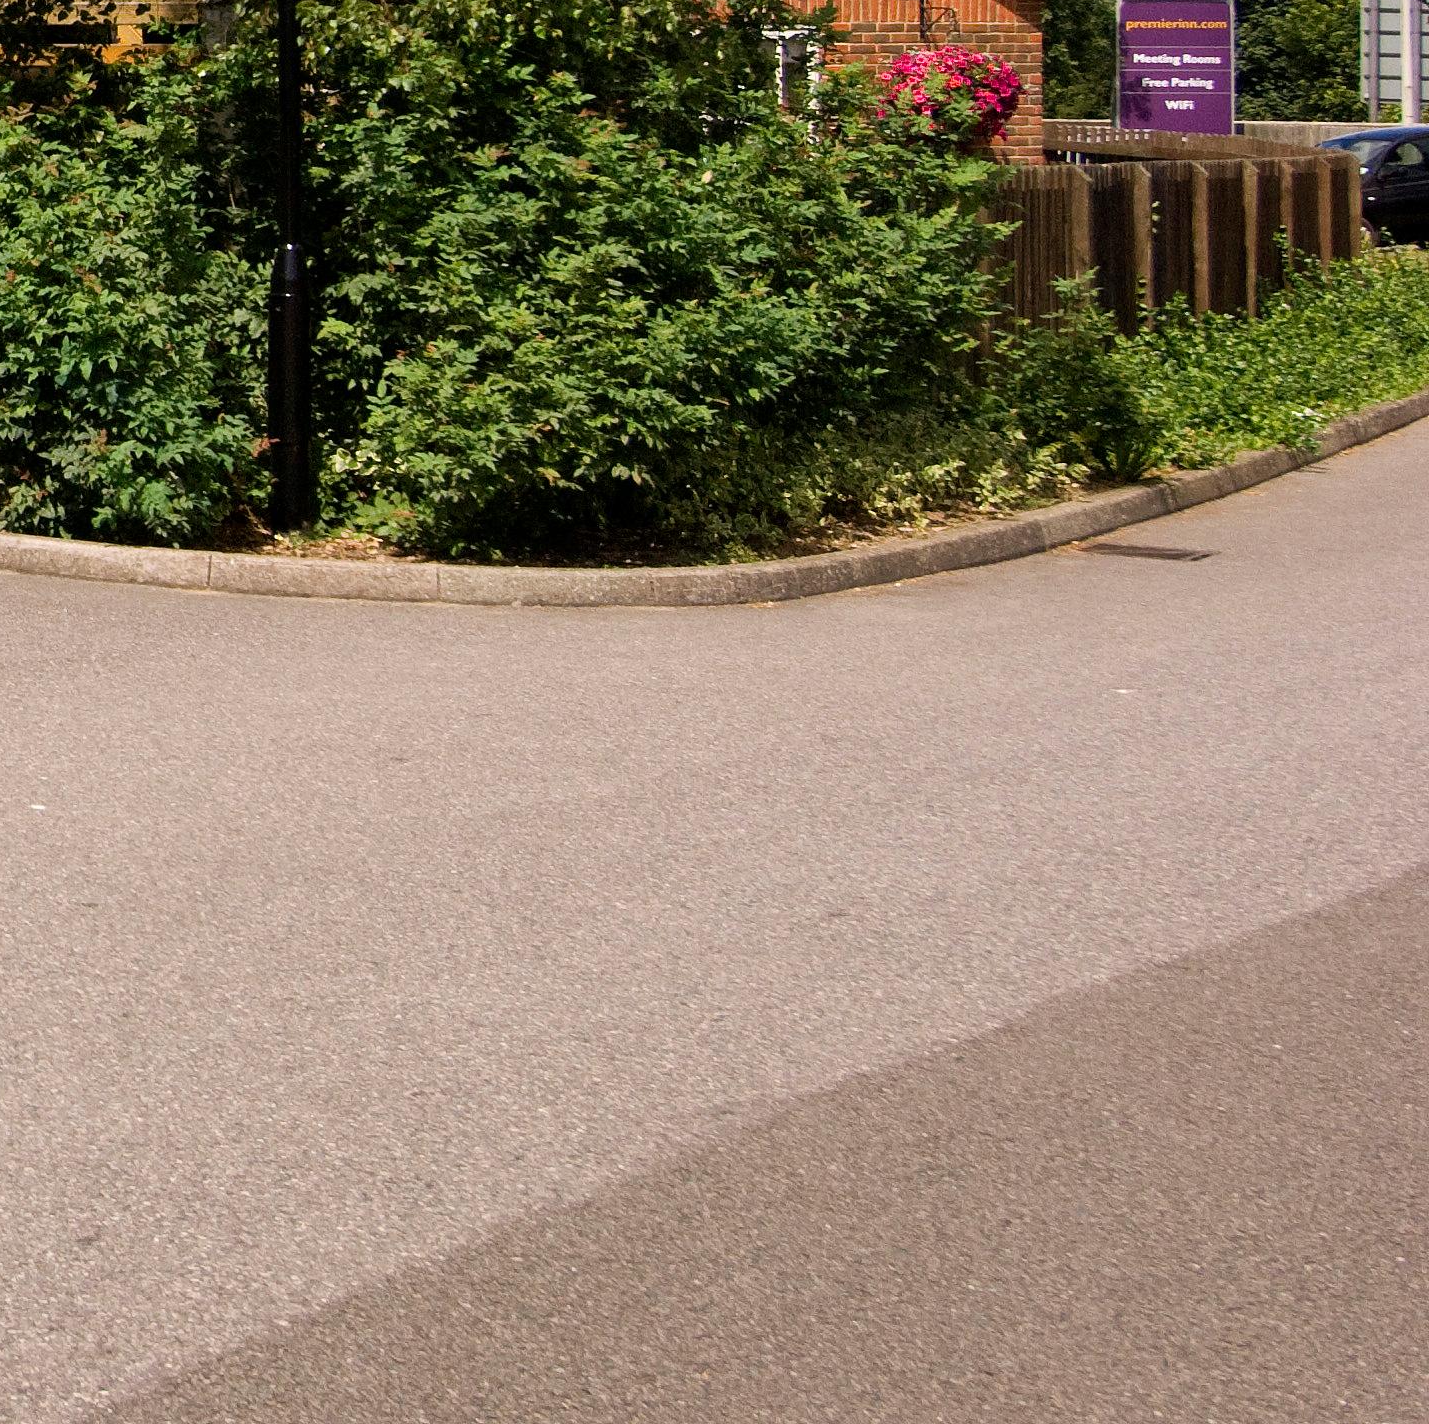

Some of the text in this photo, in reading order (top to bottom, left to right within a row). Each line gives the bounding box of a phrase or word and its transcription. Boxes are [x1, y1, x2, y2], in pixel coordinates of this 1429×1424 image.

[1125, 18, 1227, 32] premierinn.com
[1133, 53, 1222, 67] Meeting Rooms
[1141, 77, 1214, 90] Free Parking
